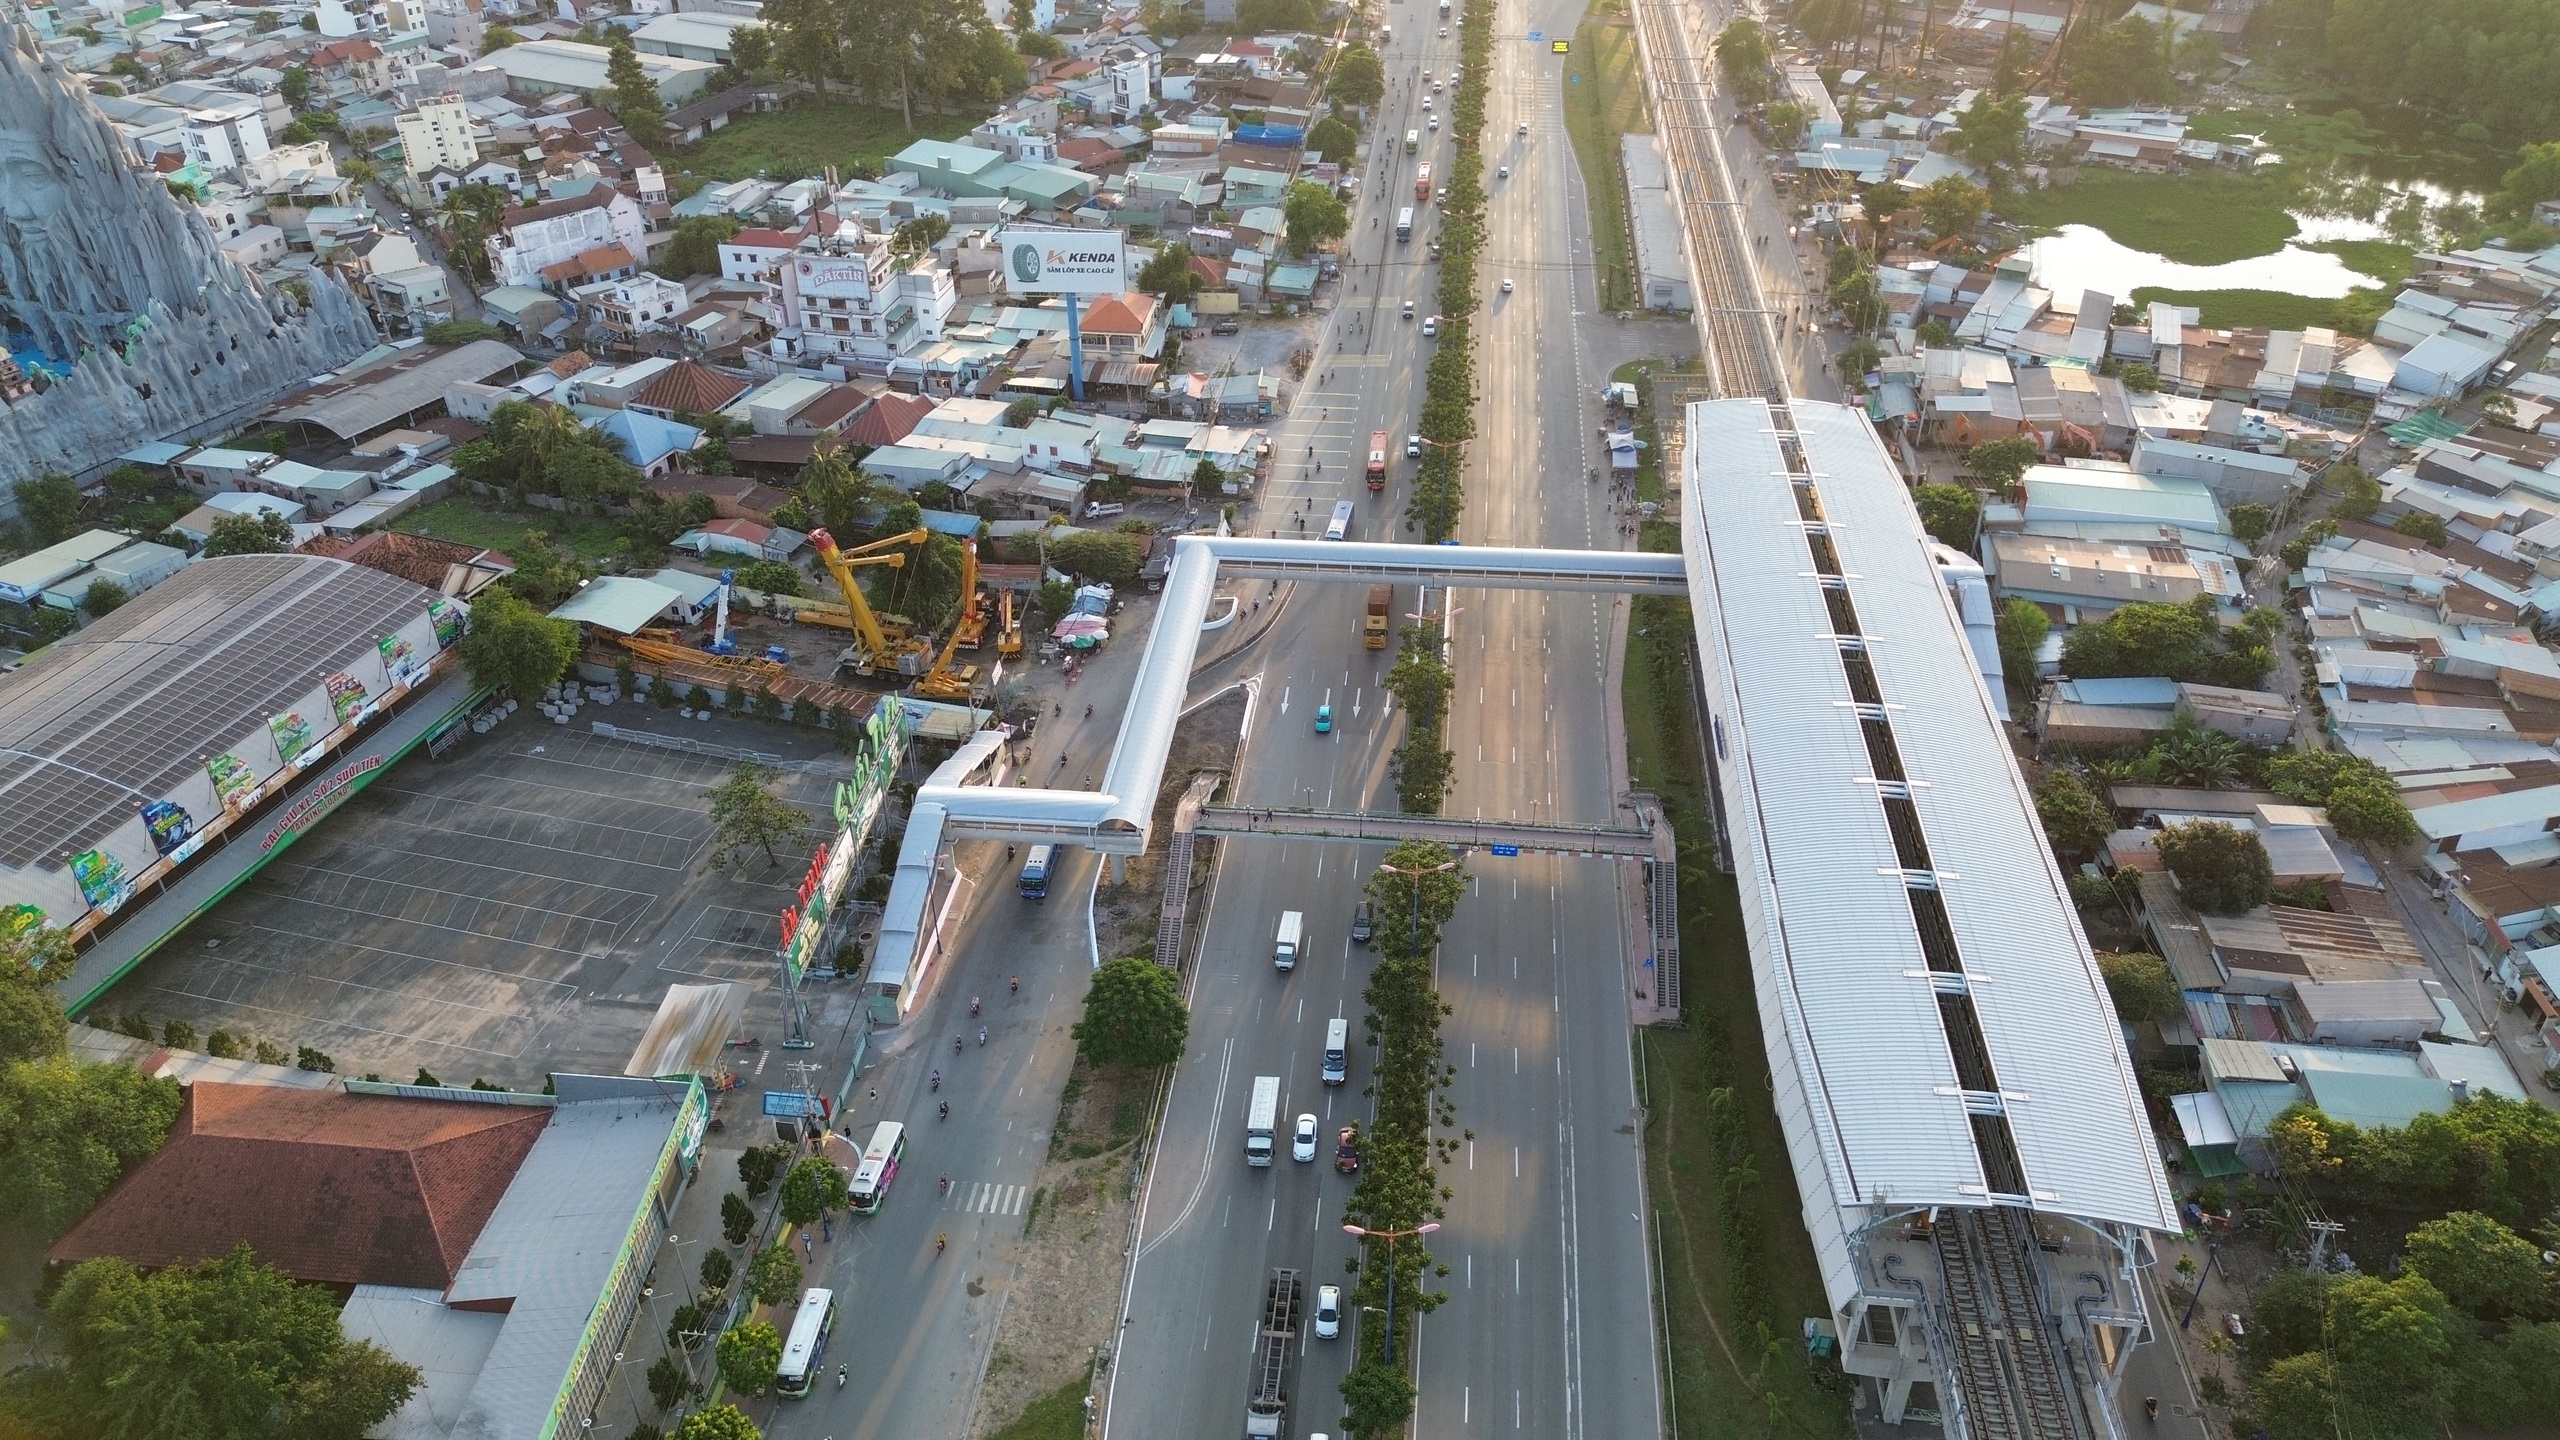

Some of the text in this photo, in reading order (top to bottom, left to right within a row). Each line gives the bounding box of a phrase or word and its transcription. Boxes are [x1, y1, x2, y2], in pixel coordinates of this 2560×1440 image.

[1068, 253, 1115, 263] KENDA
[297, 796, 312, 813] XE
[290, 804, 324, 834] PARKING
[322, 794, 338, 810] LOT
